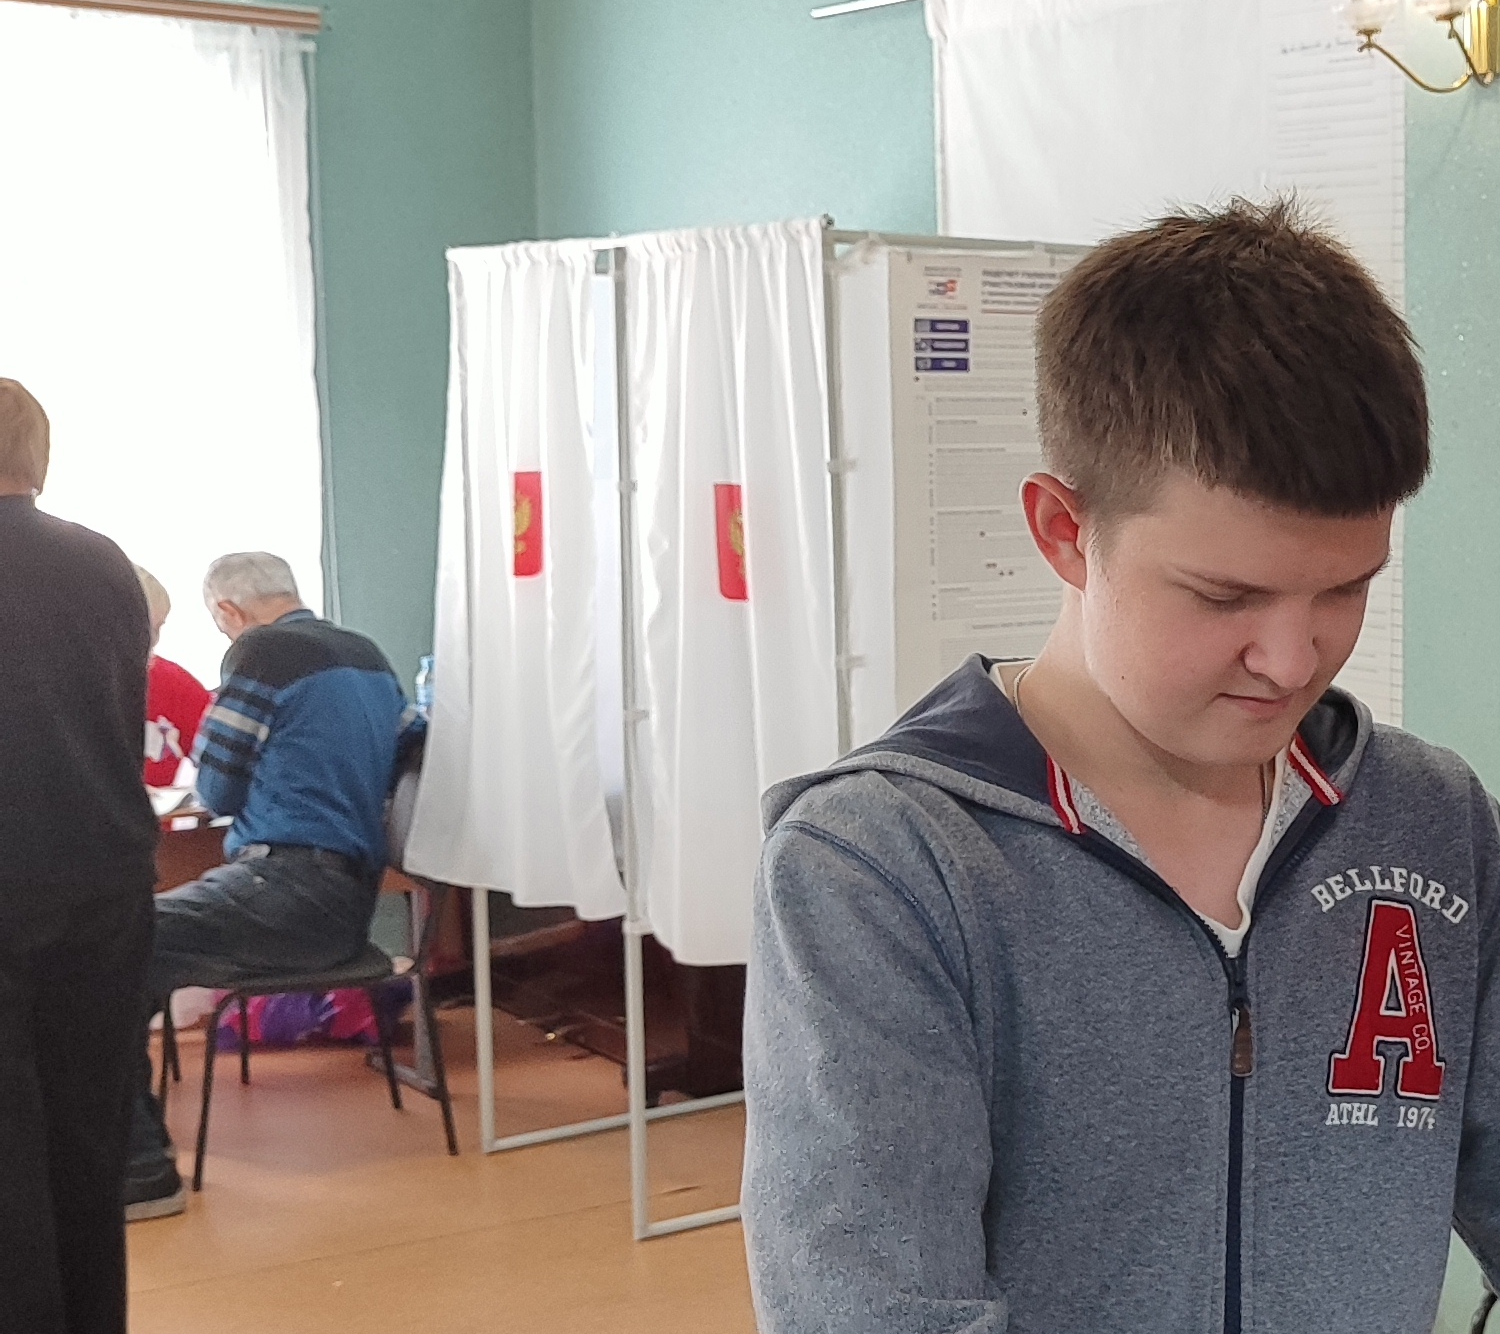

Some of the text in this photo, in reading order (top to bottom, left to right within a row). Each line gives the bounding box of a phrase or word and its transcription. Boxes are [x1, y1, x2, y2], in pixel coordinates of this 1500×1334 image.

[1311, 865, 1470, 924] BELLFORD
[1327, 896, 1446, 1102] A
[1395, 923, 1431, 1054] VINTAGE CO.
[1325, 1102, 1379, 1127] ATHL
